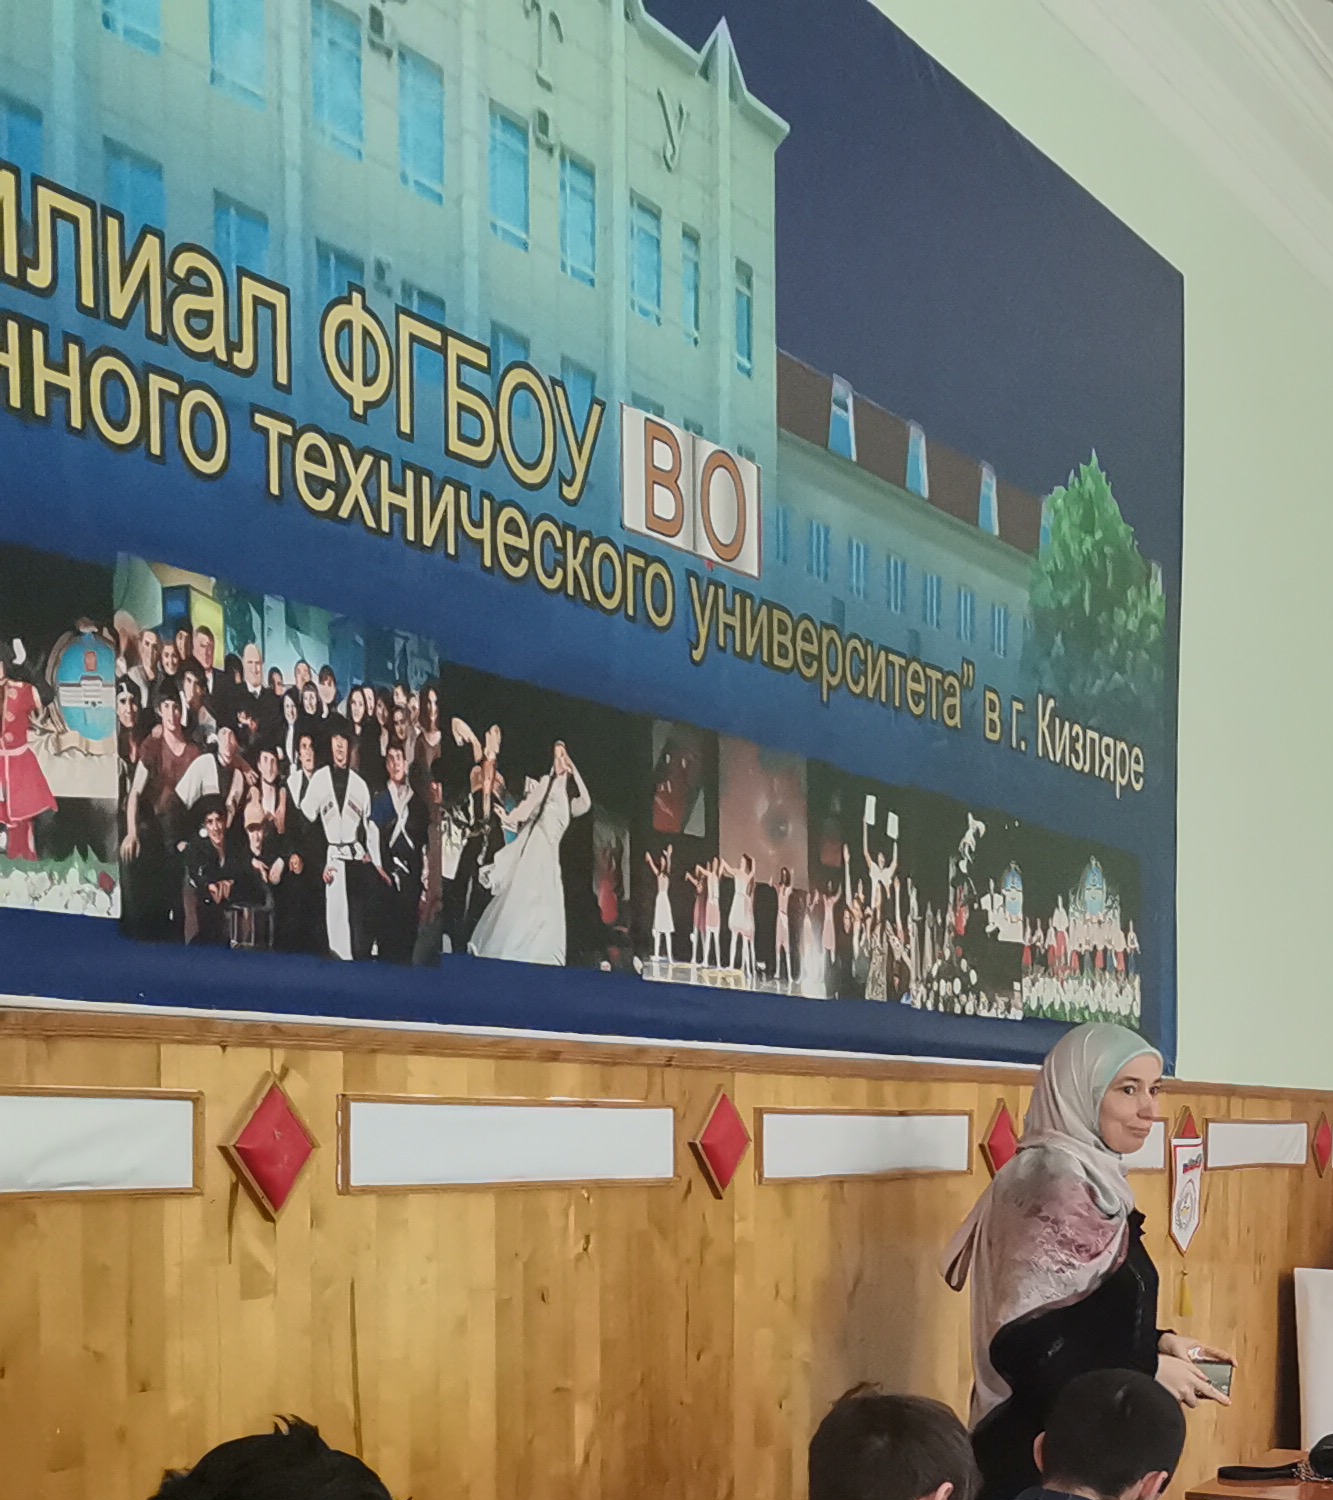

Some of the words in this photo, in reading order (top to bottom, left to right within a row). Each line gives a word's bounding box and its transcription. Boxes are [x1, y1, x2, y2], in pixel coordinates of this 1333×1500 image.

[0, 166, 290, 388] лиал
[322, 290, 605, 502] ФГБОУ
[643, 417, 748, 563] ВО
[253, 411, 674, 628] технического
[984, 690, 1002, 742] в
[1010, 701, 1028, 752] г.
[1037, 694, 1145, 799] Кизляре
